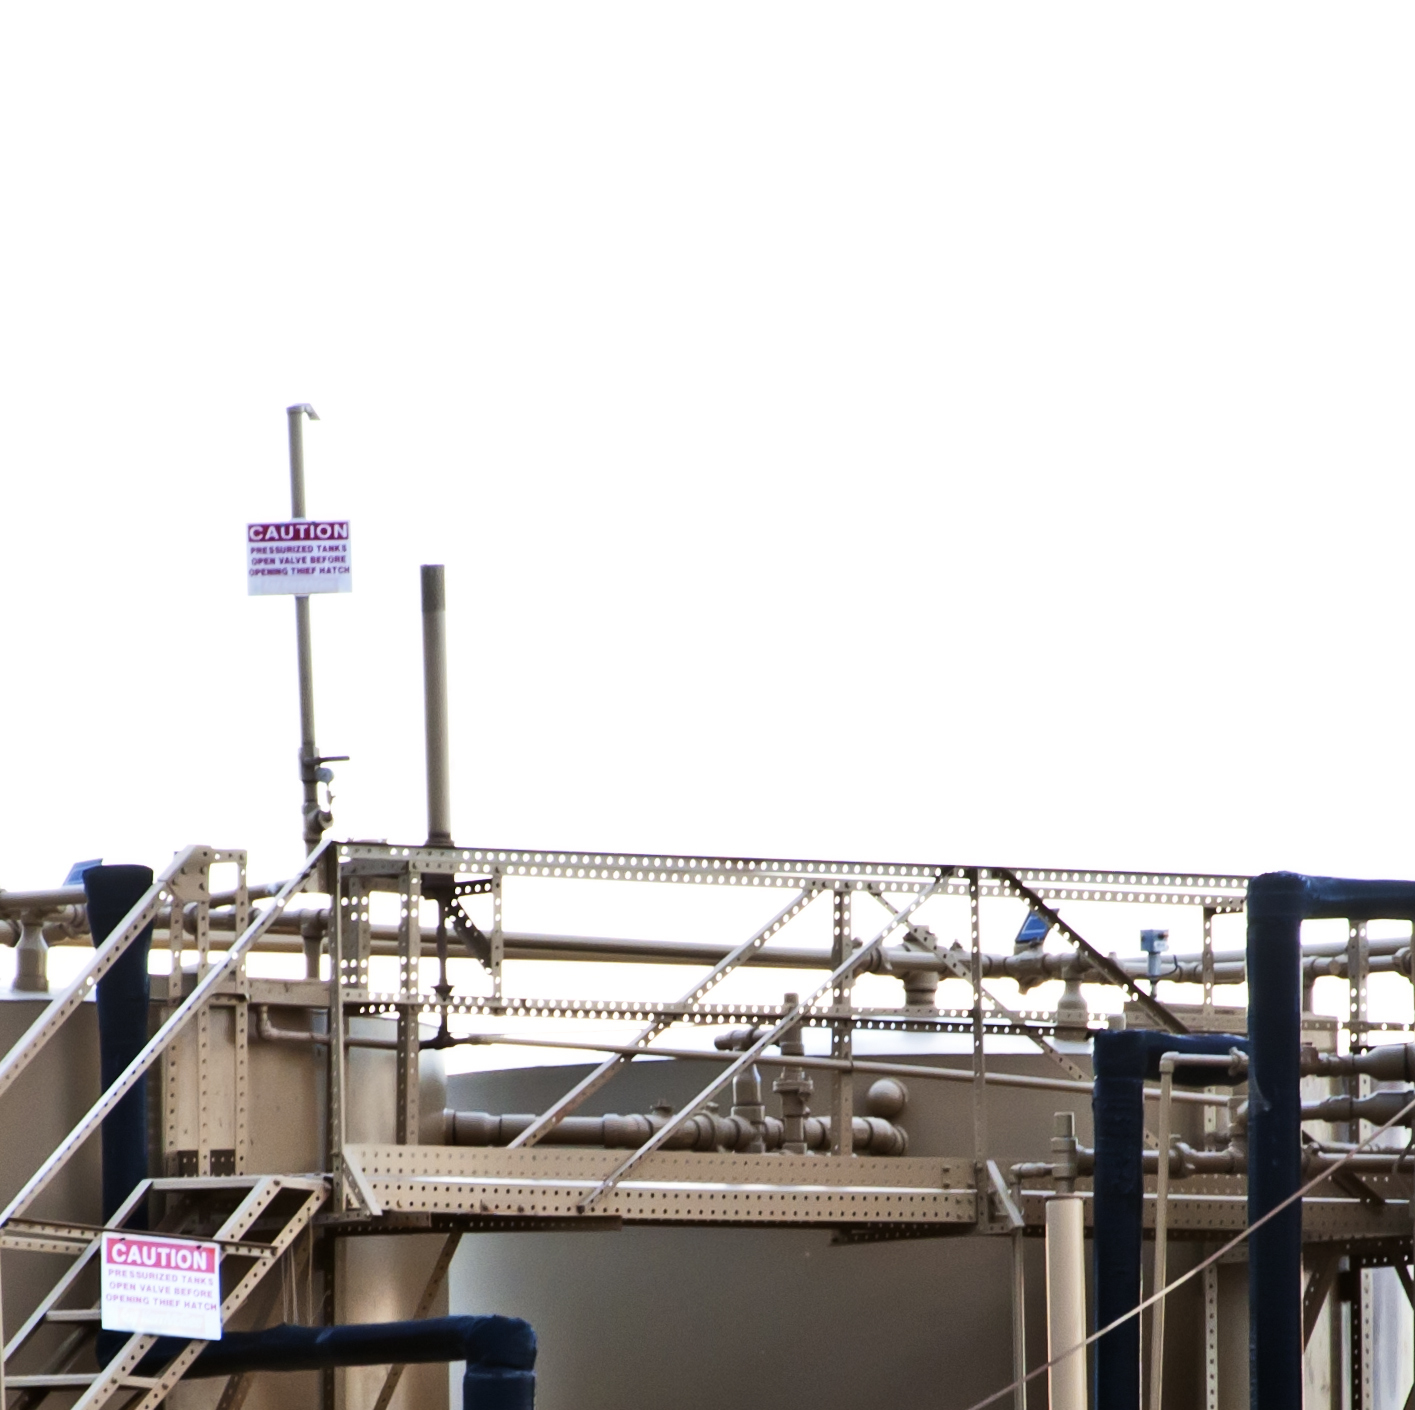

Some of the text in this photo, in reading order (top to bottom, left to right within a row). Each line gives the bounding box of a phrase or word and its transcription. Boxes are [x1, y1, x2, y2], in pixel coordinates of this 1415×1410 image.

[249, 523, 348, 540] CAUTION
[250, 544, 347, 554] PRESSURIZED TANKS
[251, 554, 346, 565] OPEN VALVE BEFORE
[249, 566, 350, 577] OPENING THIEF HATCH
[110, 1242, 208, 1271] CAUTION
[108, 1268, 214, 1286] PRESSURIZED TANKS
[109, 1281, 213, 1298] OPEN VALVE BEFORE
[106, 1292, 217, 1311] OPENING THIEF HATCH
